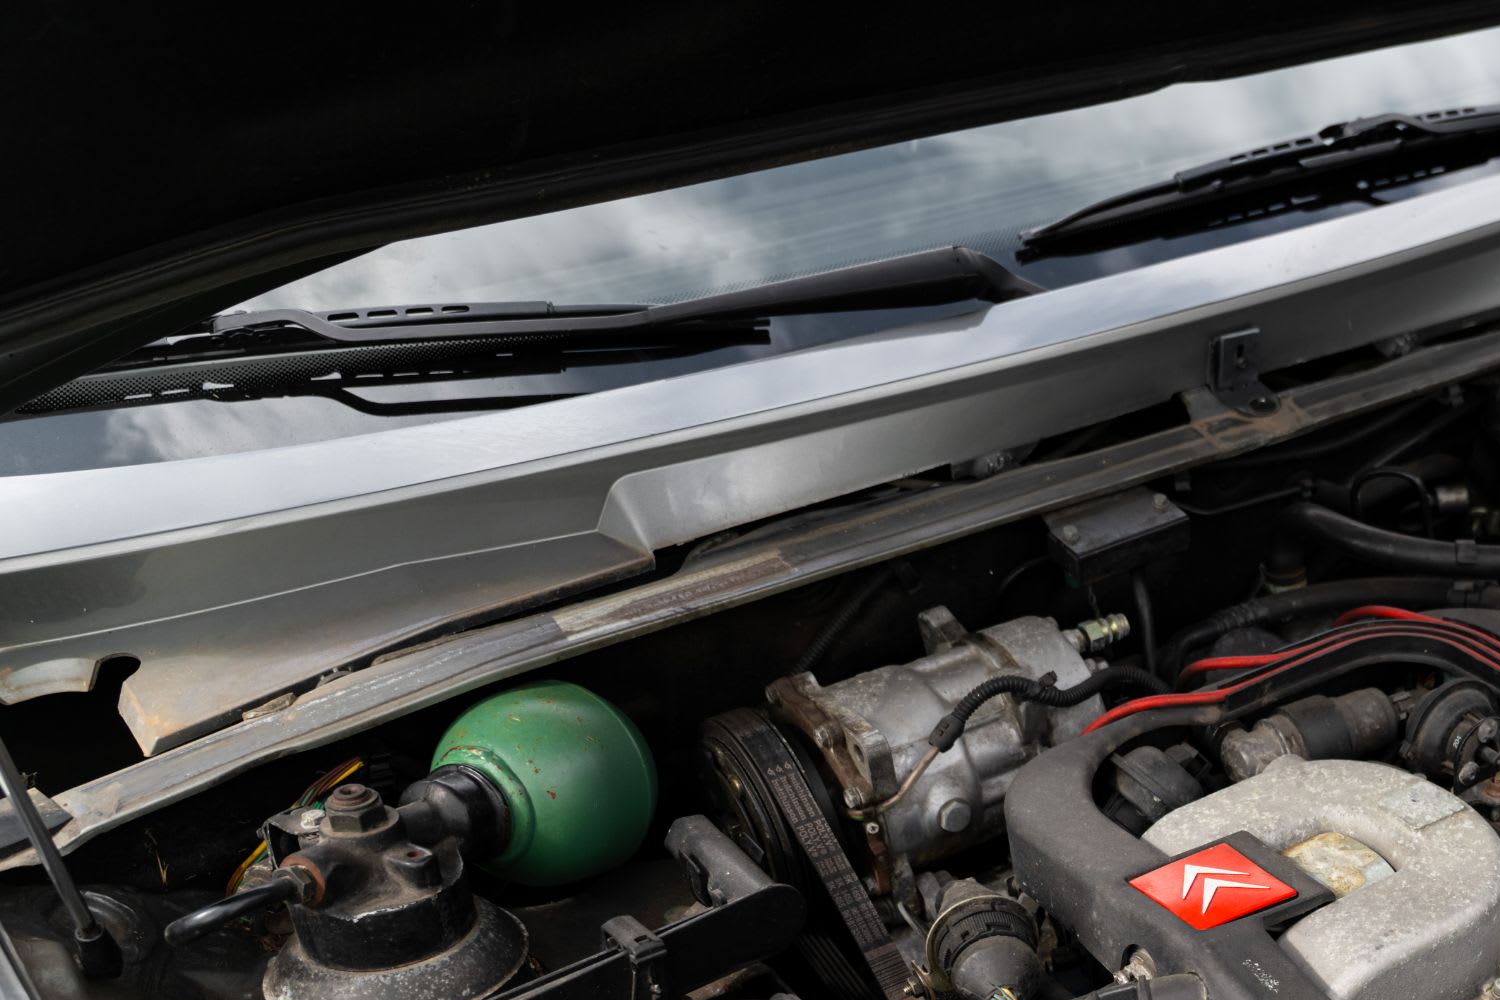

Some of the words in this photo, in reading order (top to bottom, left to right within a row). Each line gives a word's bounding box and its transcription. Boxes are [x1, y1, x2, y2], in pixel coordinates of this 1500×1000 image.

[770, 777, 799, 824] hutchinson
[778, 775, 808, 821] hutchinson
[787, 772, 817, 817] hutchinson
